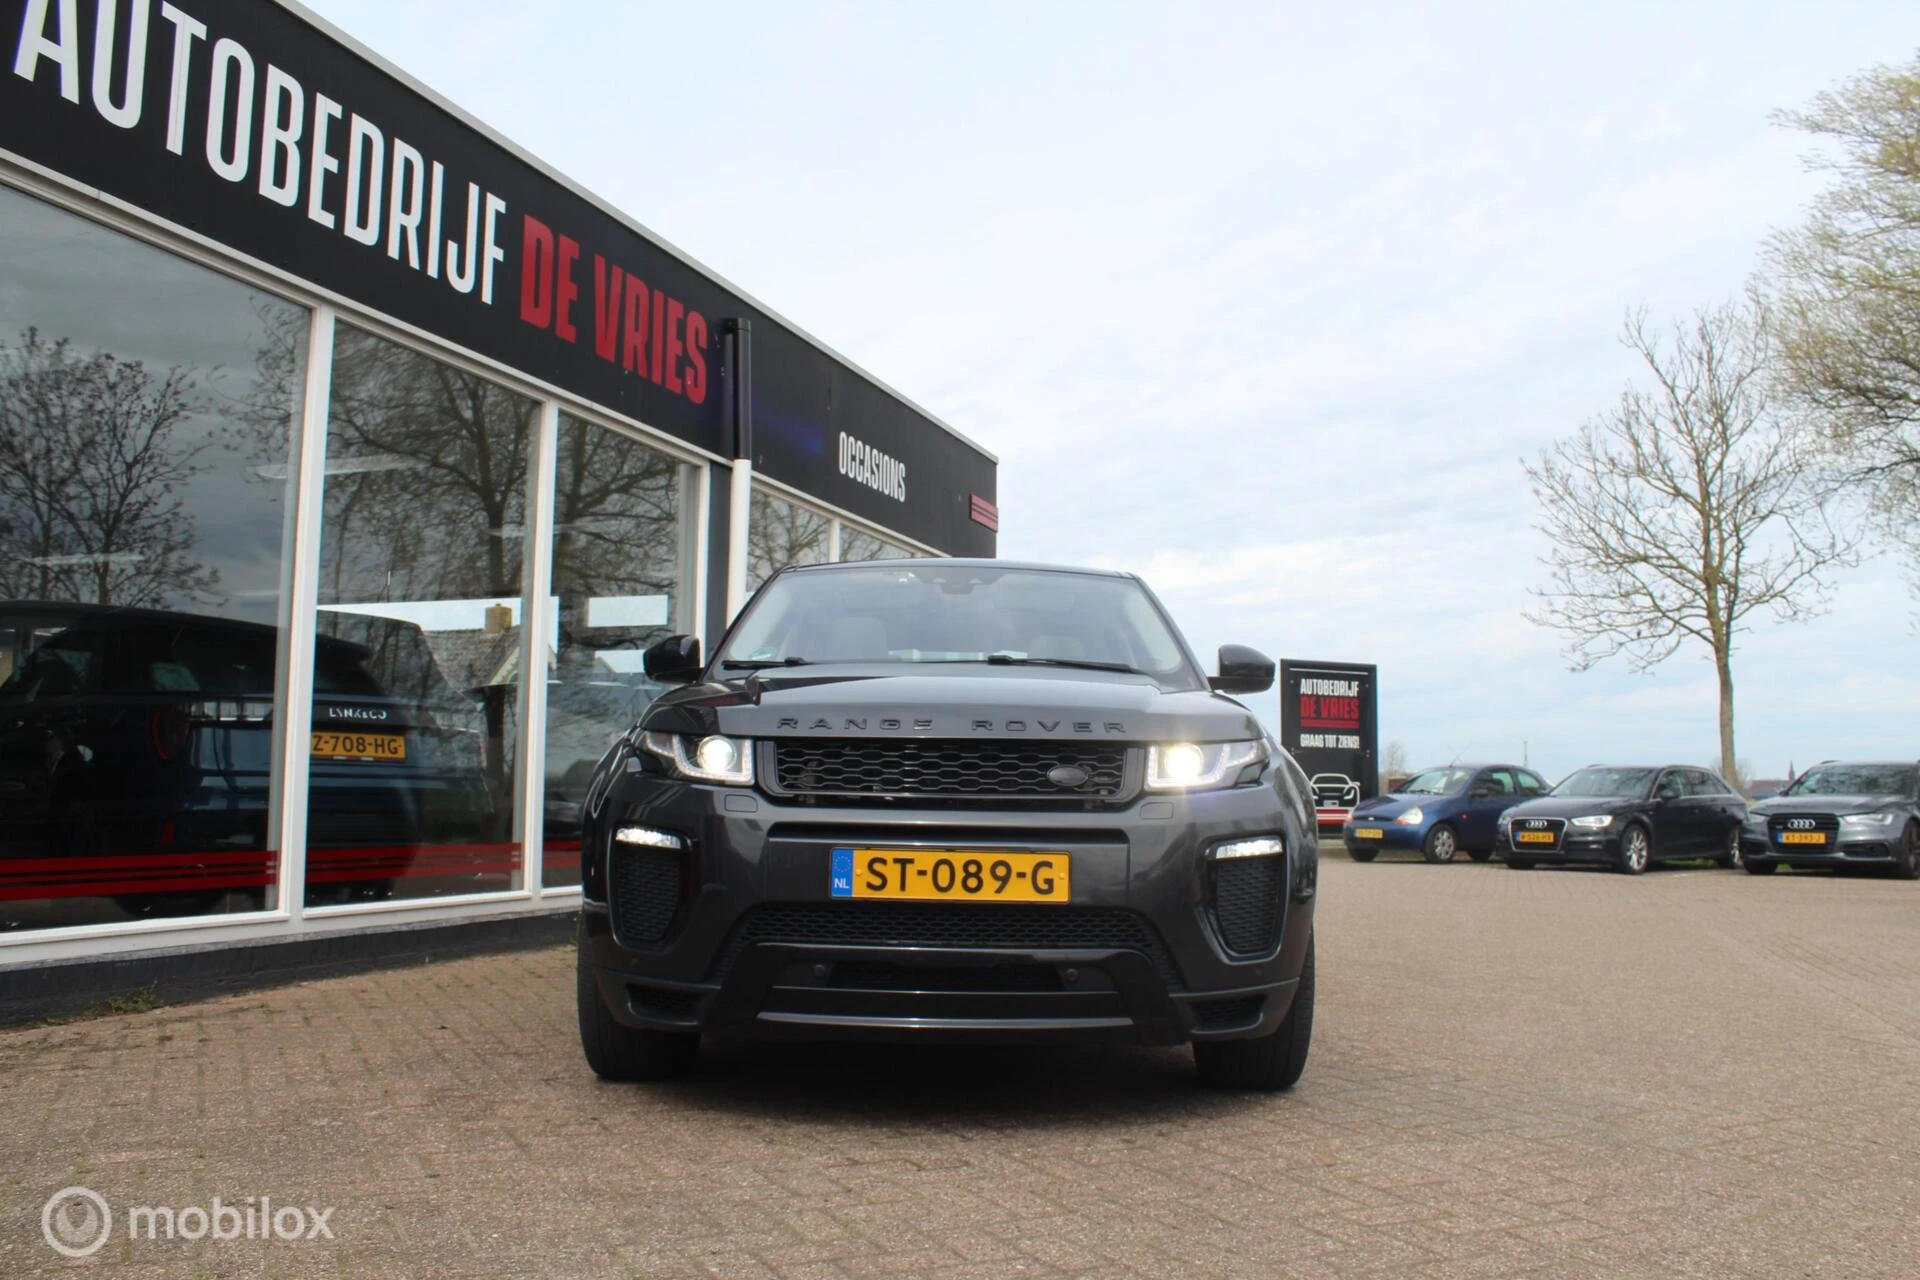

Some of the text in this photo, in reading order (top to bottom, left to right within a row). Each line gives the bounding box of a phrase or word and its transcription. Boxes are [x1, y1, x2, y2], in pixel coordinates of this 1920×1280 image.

[13, 0, 708, 404] AUTOBEDRIJF DE VRIES
[839, 431, 906, 503] OCCASIONS
[1300, 678, 1360, 697] AUTOBEDRIJF
[1300, 696, 1360, 720] DE VRIES
[776, 717, 1126, 733] RANGE ROVER
[312, 734, 399, 755] Z-708-HG
[834, 878, 850, 889] NL
[865, 856, 1055, 896] ST-089-G
